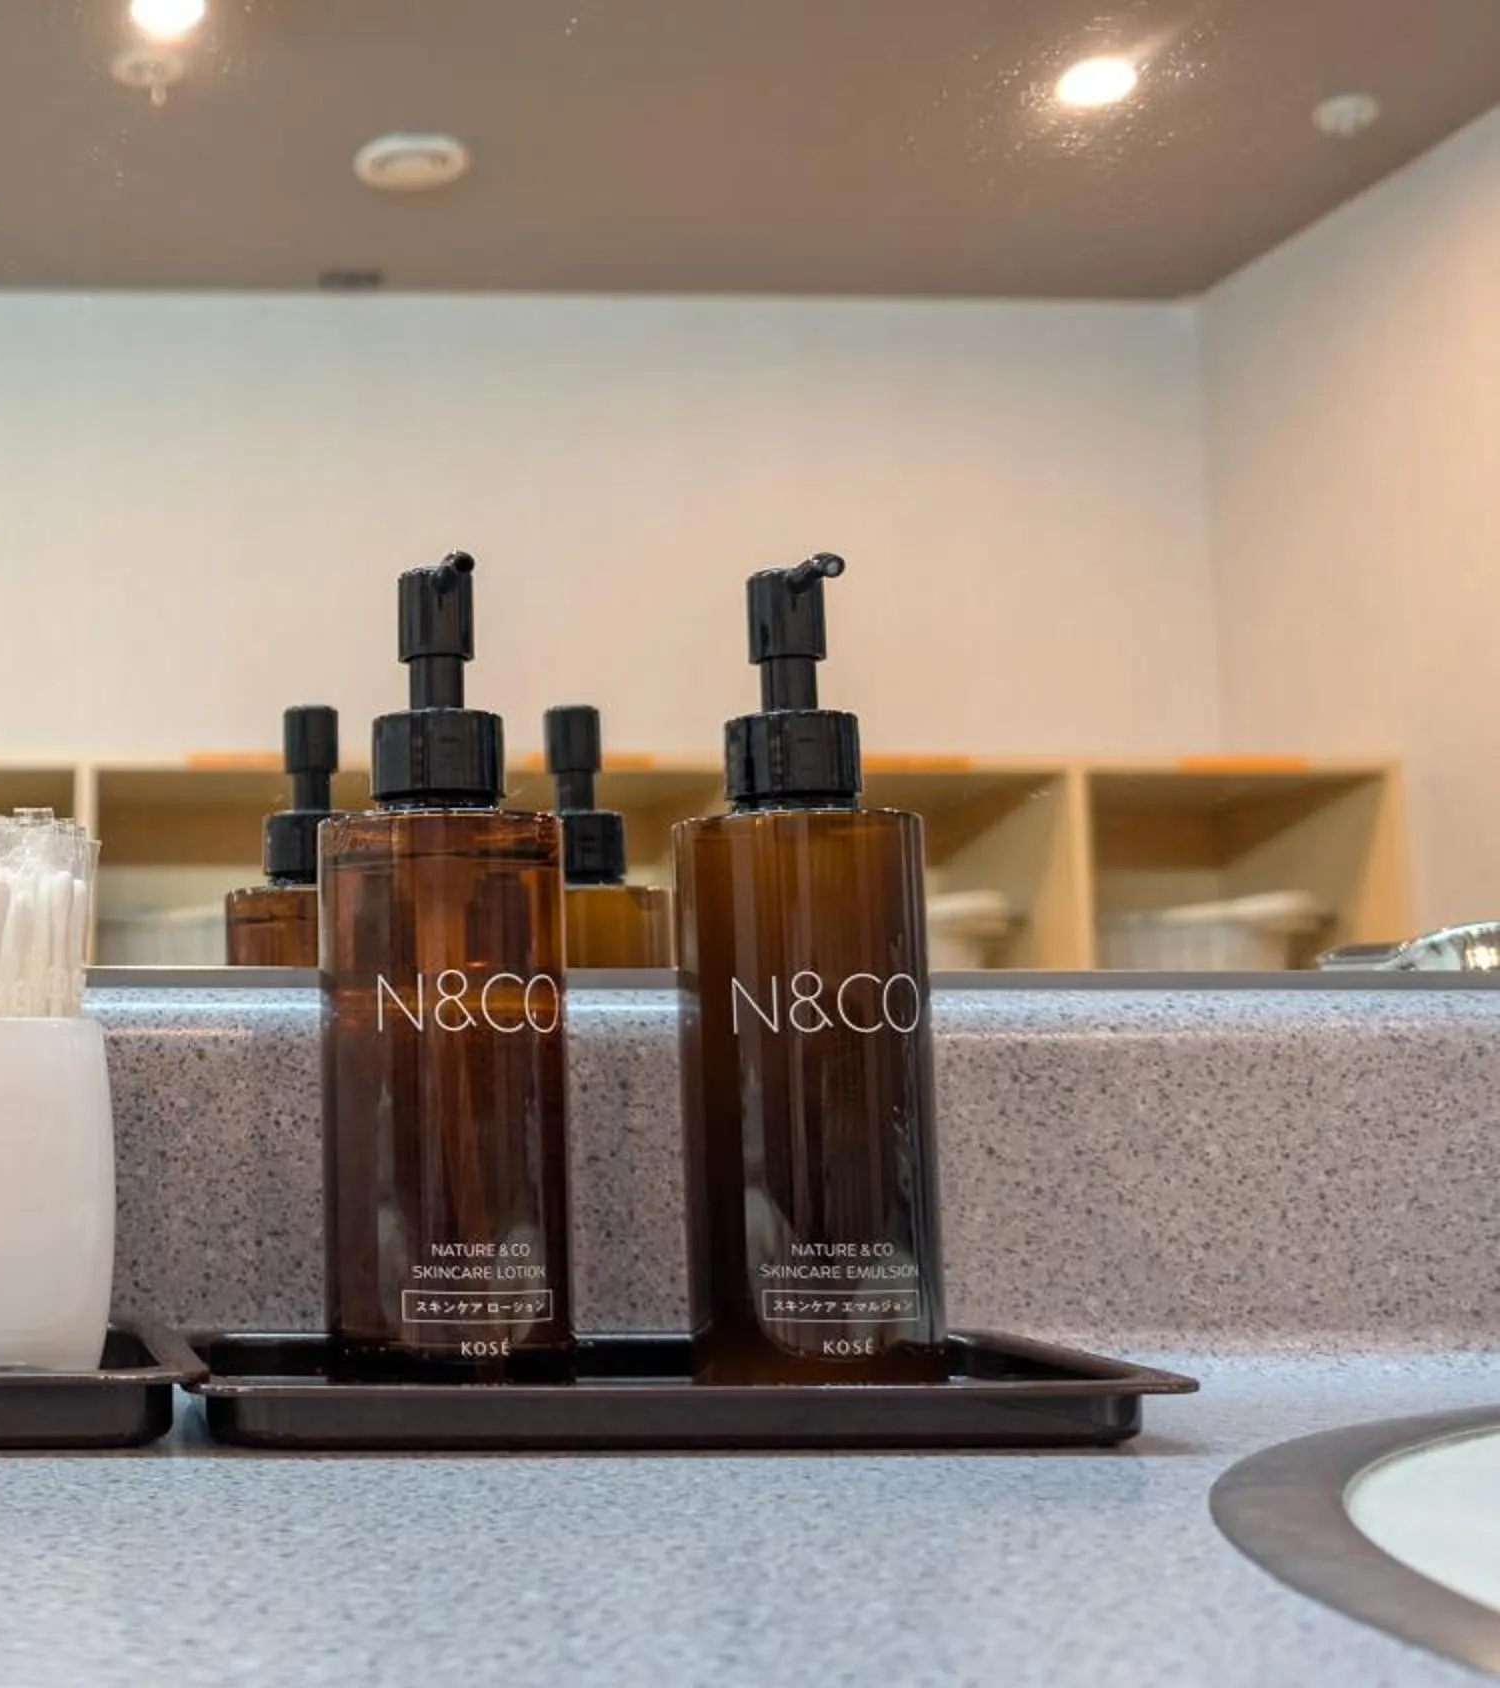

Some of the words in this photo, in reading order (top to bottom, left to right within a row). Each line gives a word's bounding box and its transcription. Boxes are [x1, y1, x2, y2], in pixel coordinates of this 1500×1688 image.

[377, 969, 560, 1033] N&CO
[731, 970, 921, 1035] N&CO
[431, 1243, 496, 1257] NATURE
[499, 1243, 509, 1257] &
[510, 1243, 531, 1257] CO
[791, 1243, 857, 1257] NATURE
[860, 1243, 871, 1257] &
[873, 1243, 895, 1257] CO
[412, 1265, 493, 1280] SKINCARE
[497, 1265, 547, 1280] LOTION
[758, 1264, 841, 1280] SKINCARE
[847, 1264, 919, 1280] EMULSION
[416, 1300, 483, 1315] スキンケア
[487, 1300, 546, 1314] ローション
[773, 1300, 837, 1314] スキンケア
[842, 1299, 914, 1314] エマルジョン
[461, 1337, 511, 1357] KOSÉ
[823, 1336, 874, 1356] KOSÉ
